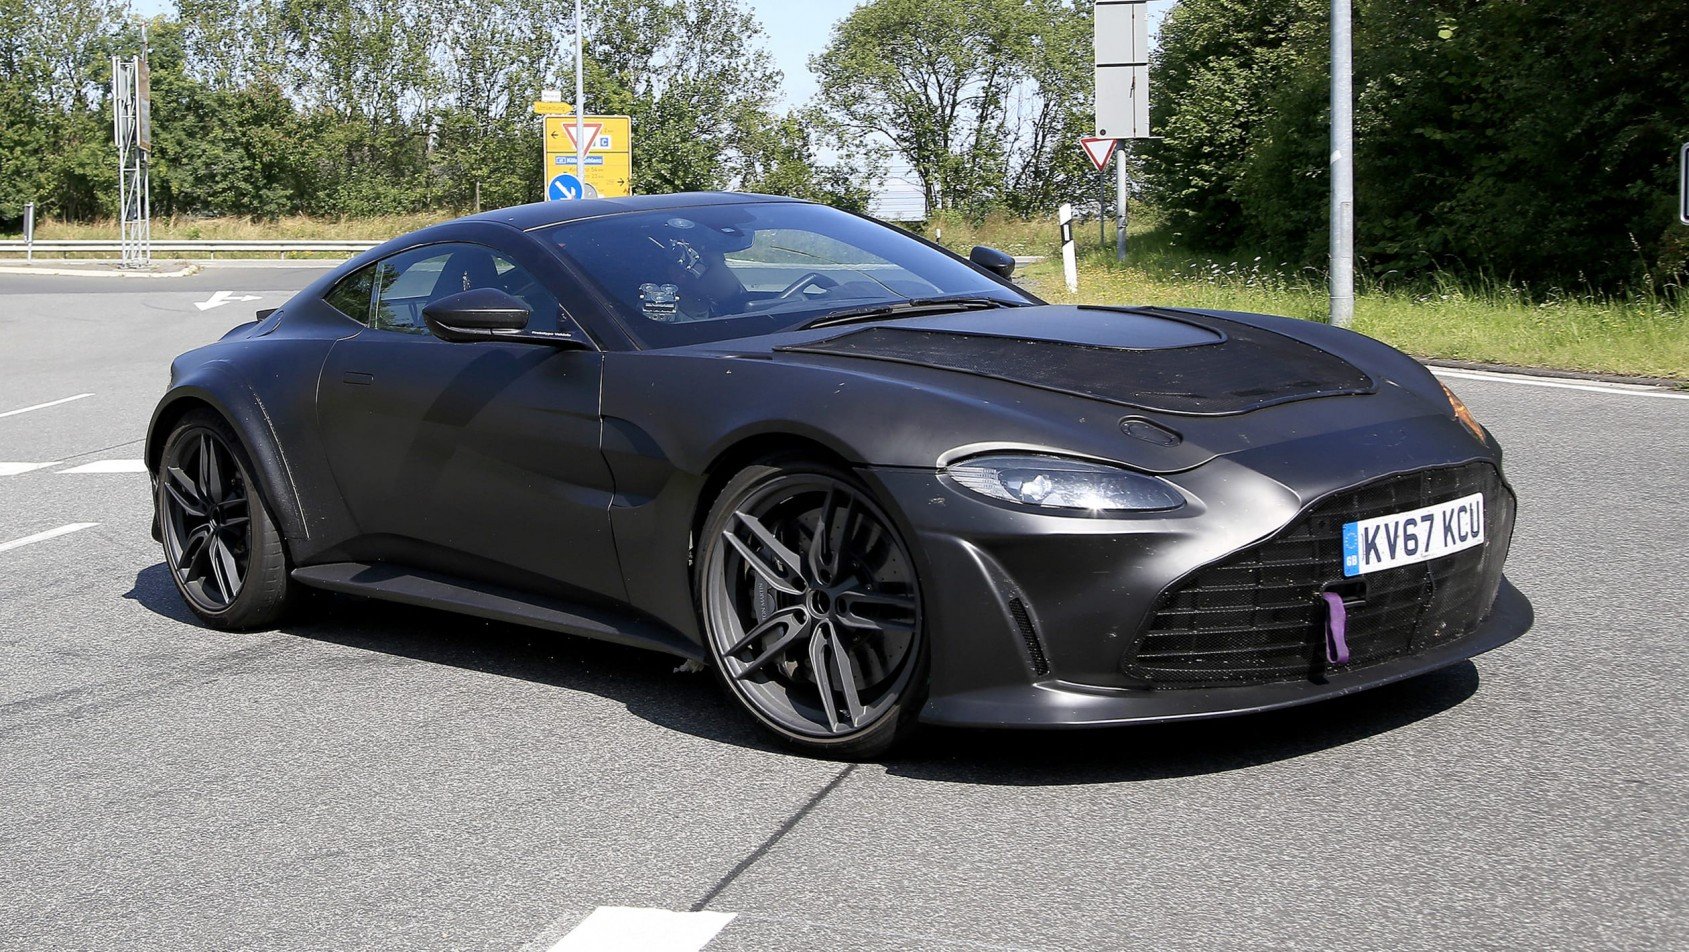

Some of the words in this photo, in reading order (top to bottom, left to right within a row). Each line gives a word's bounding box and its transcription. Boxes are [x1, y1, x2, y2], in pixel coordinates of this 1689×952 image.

[1364, 513, 1434, 565] KV67
[1442, 501, 1480, 547] KCU
[1346, 555, 1358, 567] GB
